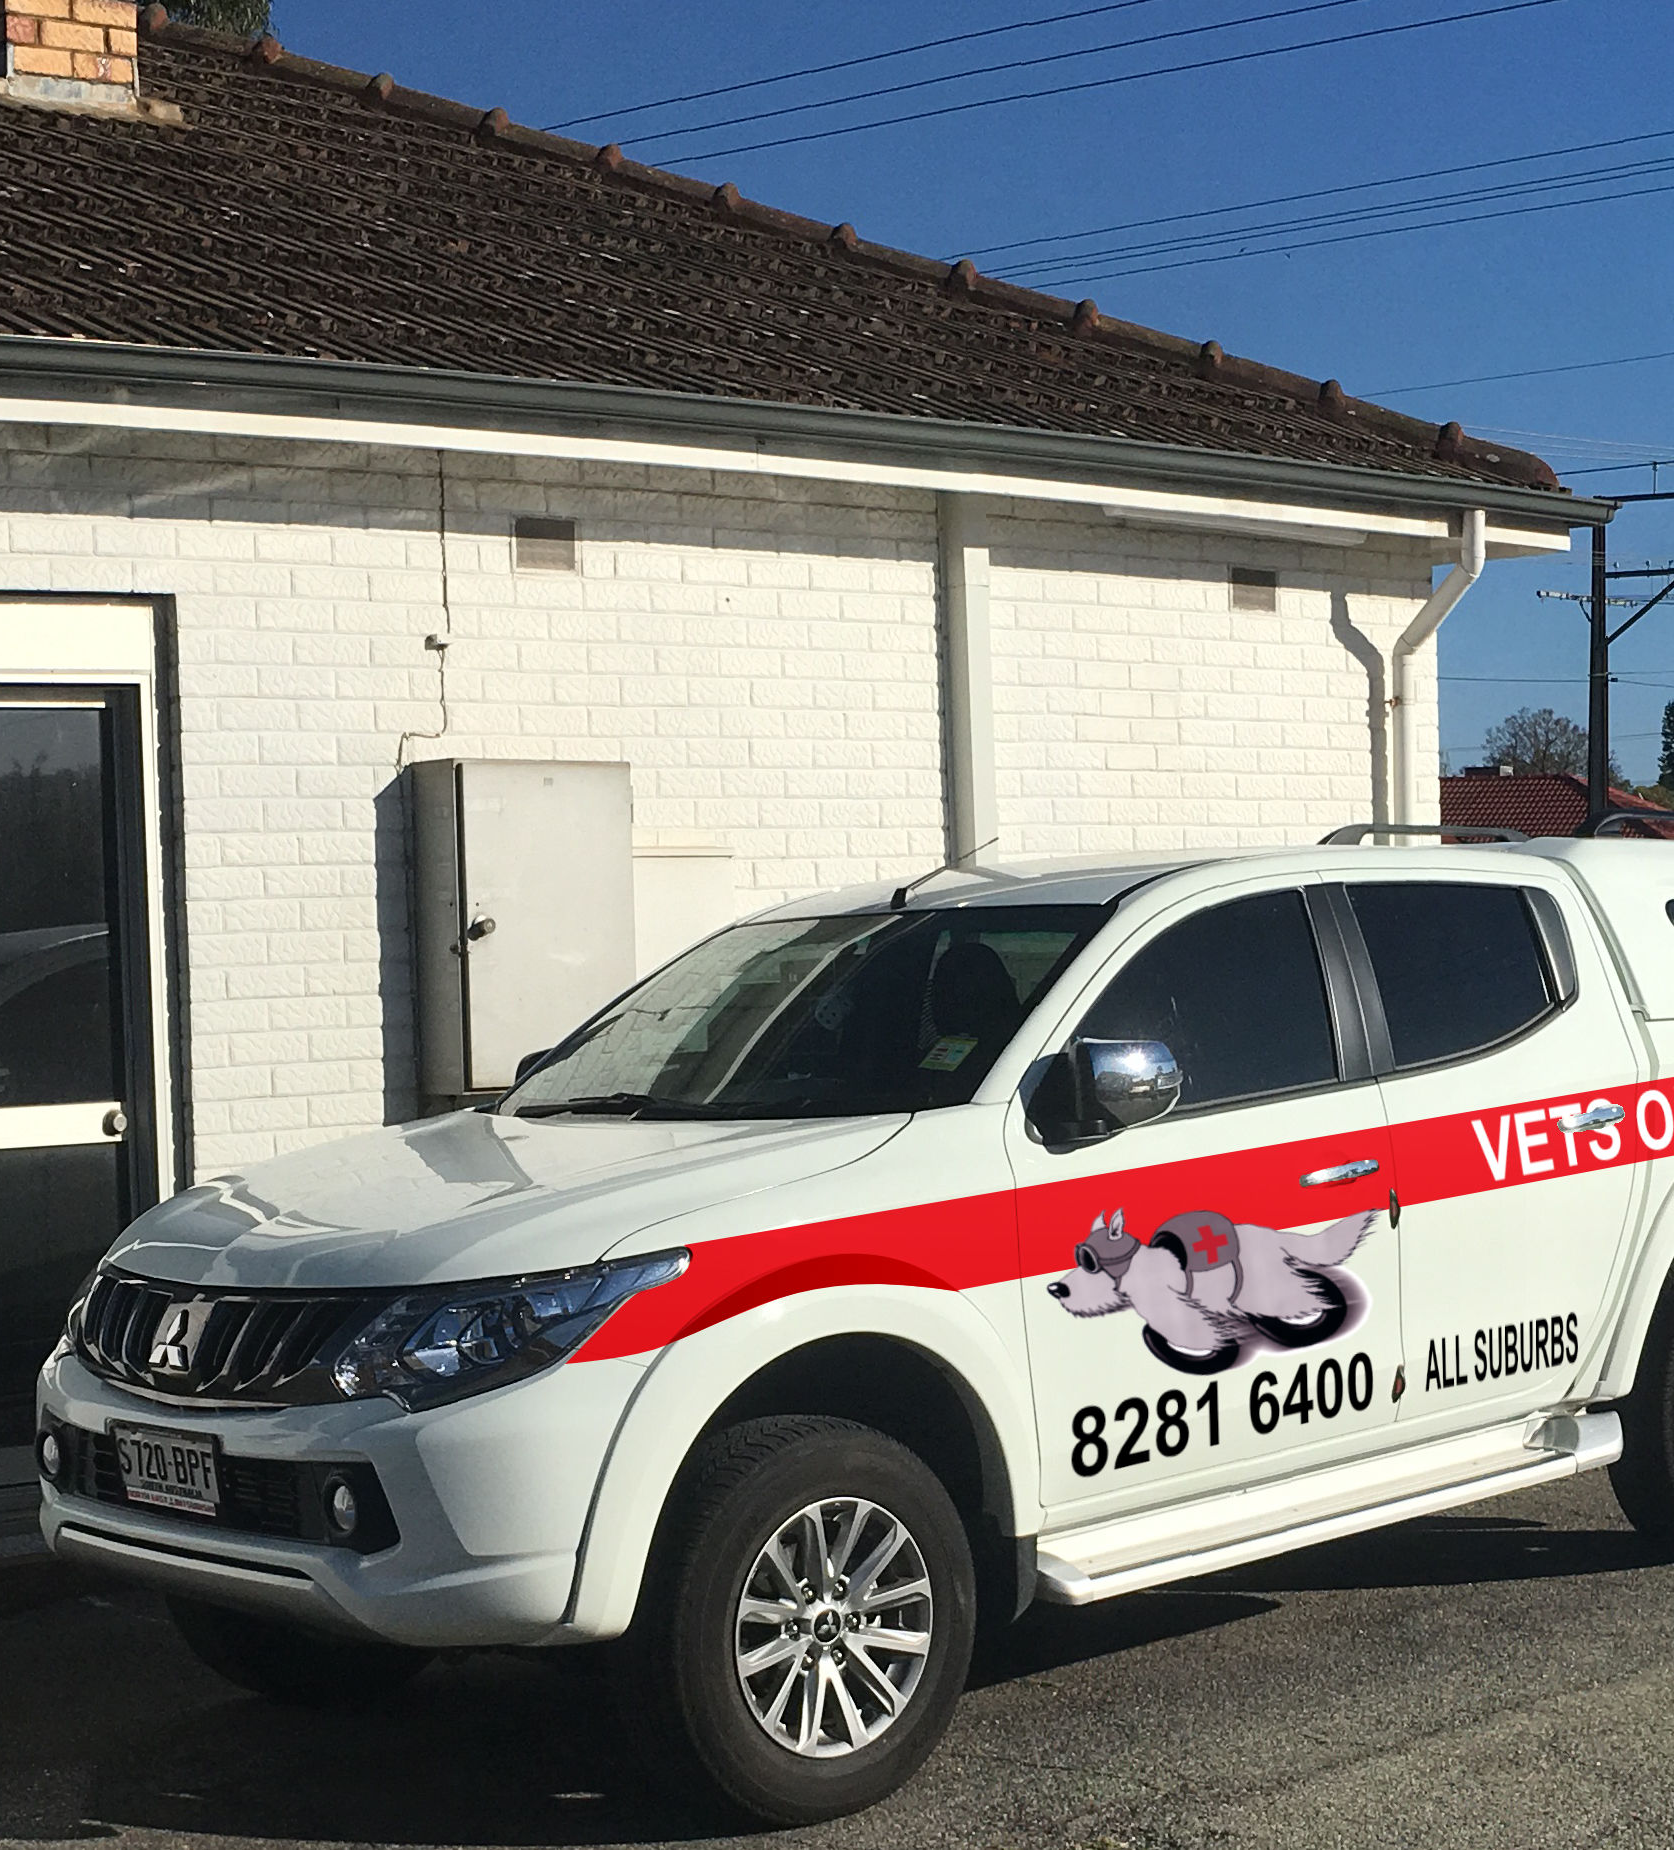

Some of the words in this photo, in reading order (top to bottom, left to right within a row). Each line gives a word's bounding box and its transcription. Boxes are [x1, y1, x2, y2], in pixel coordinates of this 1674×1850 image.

[1471, 1098, 1621, 1181] VETS
[1424, 1333, 1469, 1392] ALL
[1473, 1312, 1580, 1383] SUBURBS
[1071, 1380, 1221, 1477] 8281
[1248, 1352, 1375, 1435] 6400
[118, 1438, 212, 1489] S720-BPF
